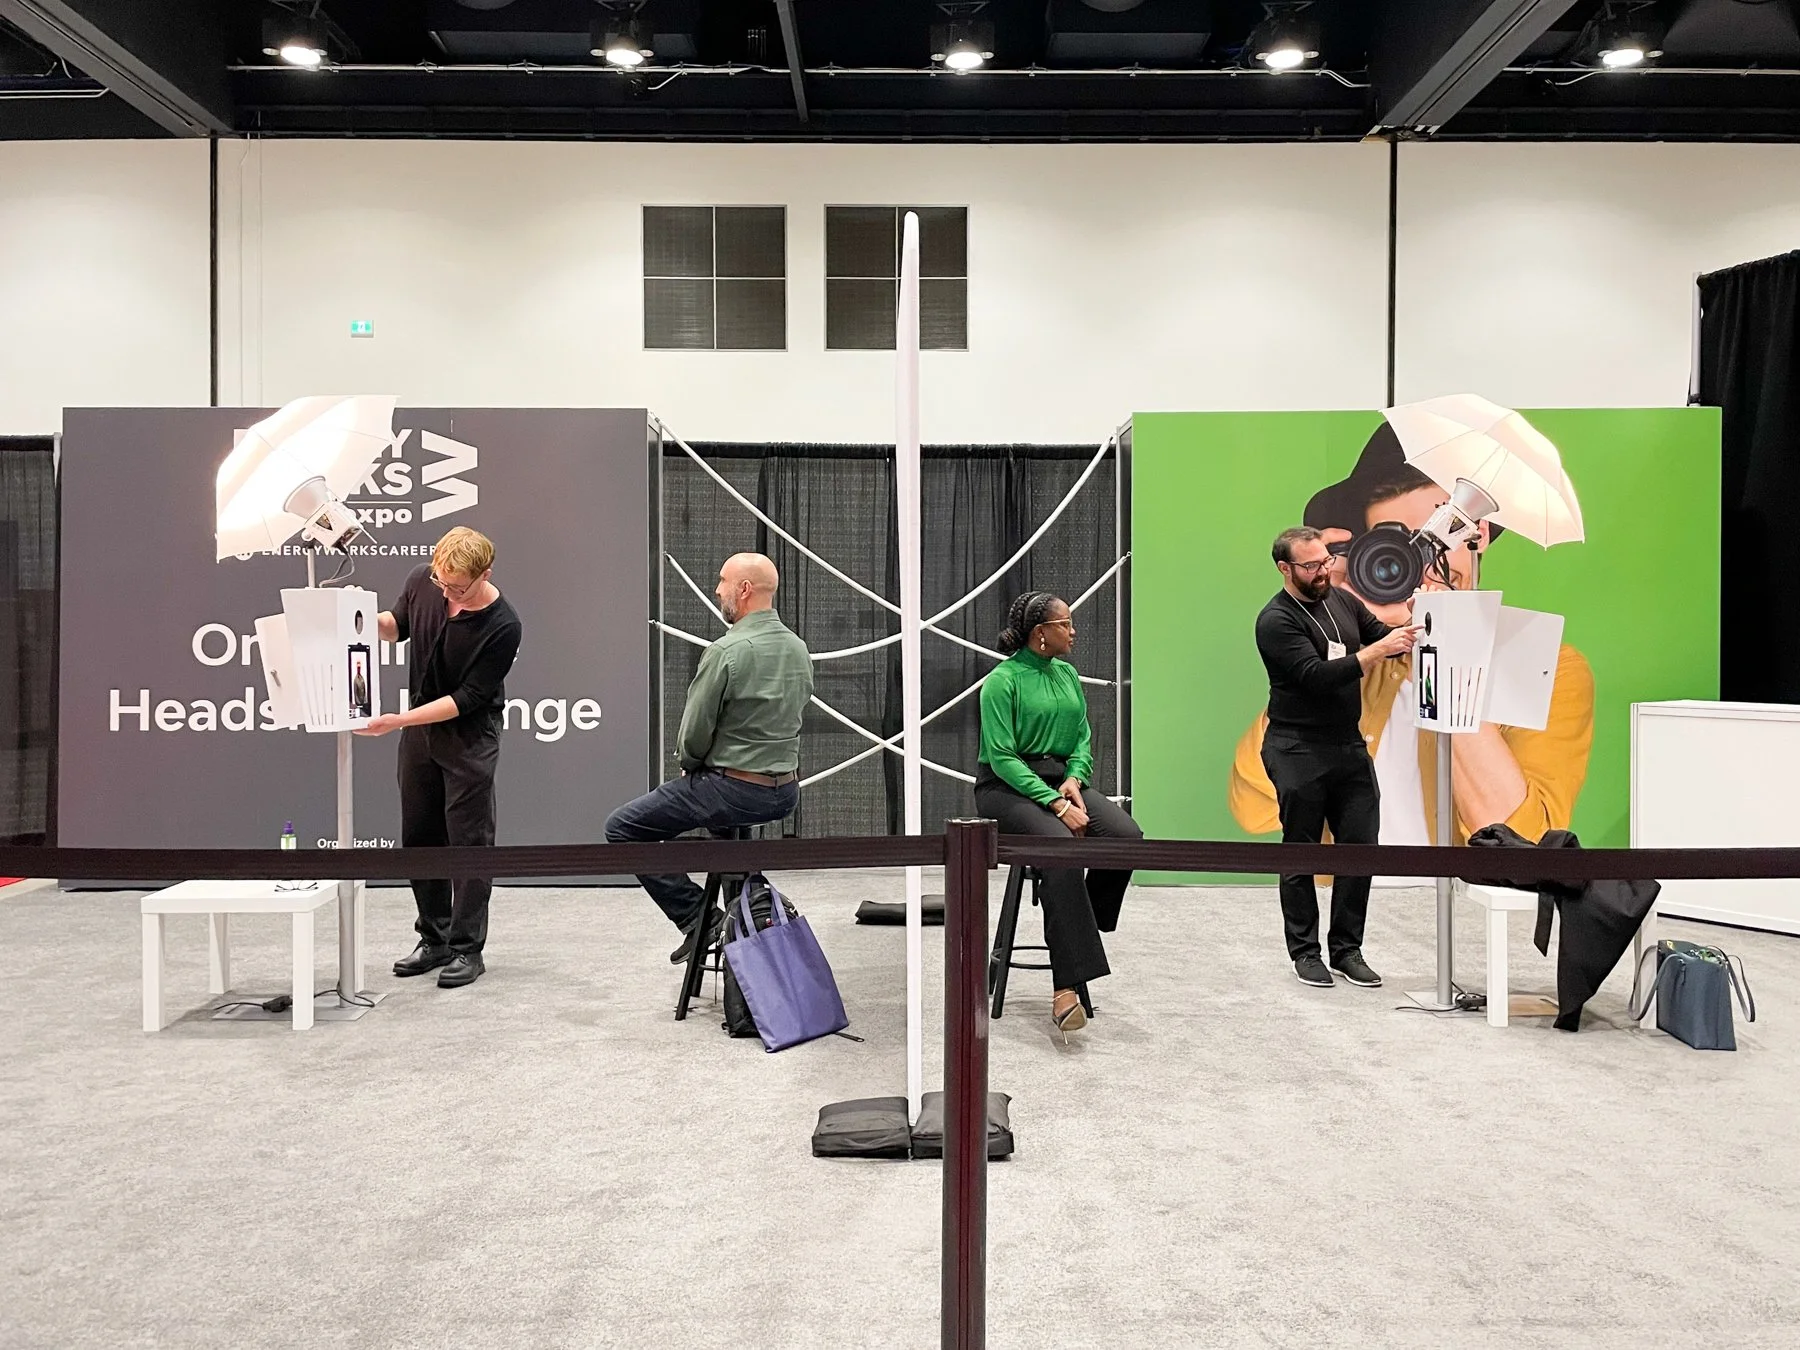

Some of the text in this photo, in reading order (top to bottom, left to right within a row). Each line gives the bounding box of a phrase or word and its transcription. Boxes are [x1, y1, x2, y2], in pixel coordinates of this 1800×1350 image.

[109, 686, 299, 732] Heads
[317, 838, 396, 849] Orgized by
